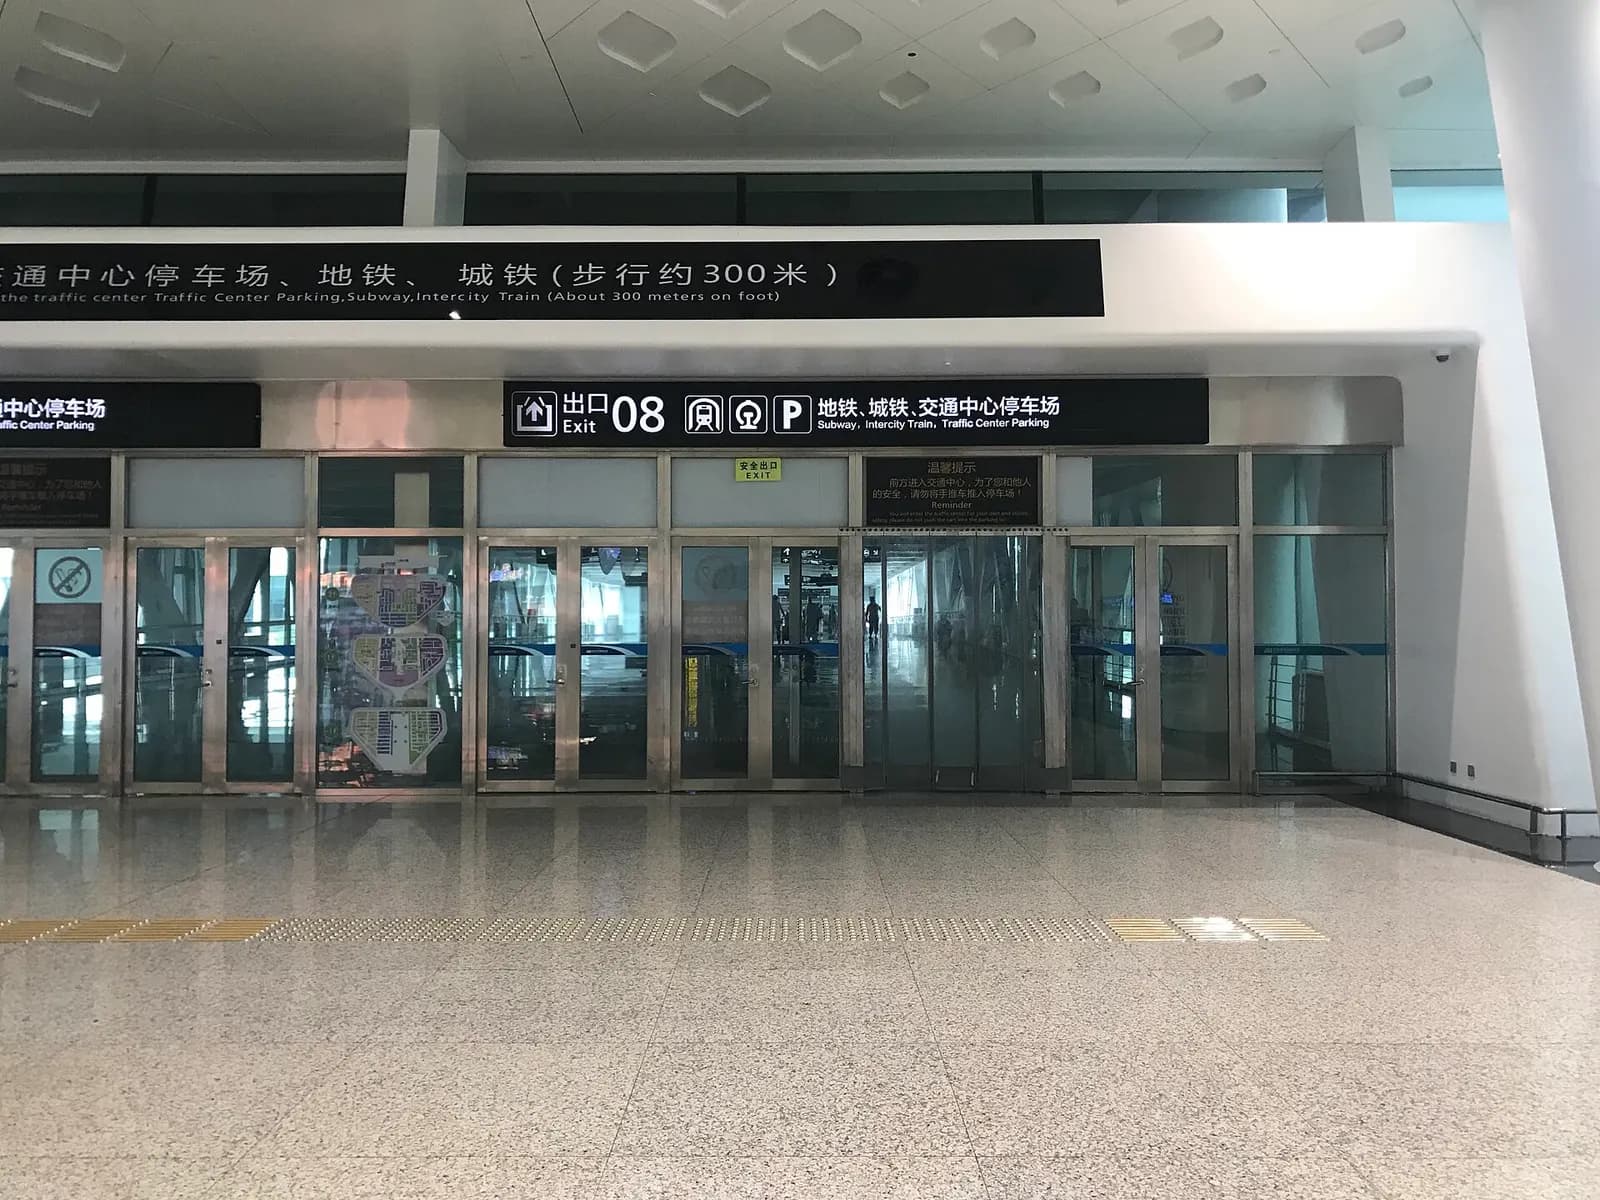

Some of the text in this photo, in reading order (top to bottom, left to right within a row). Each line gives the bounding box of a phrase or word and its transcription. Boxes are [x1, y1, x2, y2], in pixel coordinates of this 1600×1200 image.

[0, 292, 28, 303] the
[34, 292, 86, 303] traffic
[92, 294, 147, 303] center
[153, 292, 207, 303] Traffic
[214, 292, 271, 303] Center
[498, 291, 540, 302] Train
[547, 291, 606, 303] (About
[611, 291, 641, 302] 300
[648, 292, 704, 302] meters
[710, 292, 731, 301] on
[737, 290, 780, 303] foot)
[0, 397, 107, 419] 中心停车场
[562, 391, 608, 415] 出口
[817, 395, 1060, 419] 地铁、城铁、交通中心停车场
[611, 395, 665, 433] 08
[19, 419, 55, 430] Center
[56, 419, 96, 432] Parking
[563, 419, 597, 434] Exit
[817, 417, 1050, 431] Subway, Intercity Train, Traffic Center Parking
[739, 460, 778, 471] 安全出口
[745, 471, 771, 480] EXIT
[931, 501, 973, 511] Reminder
